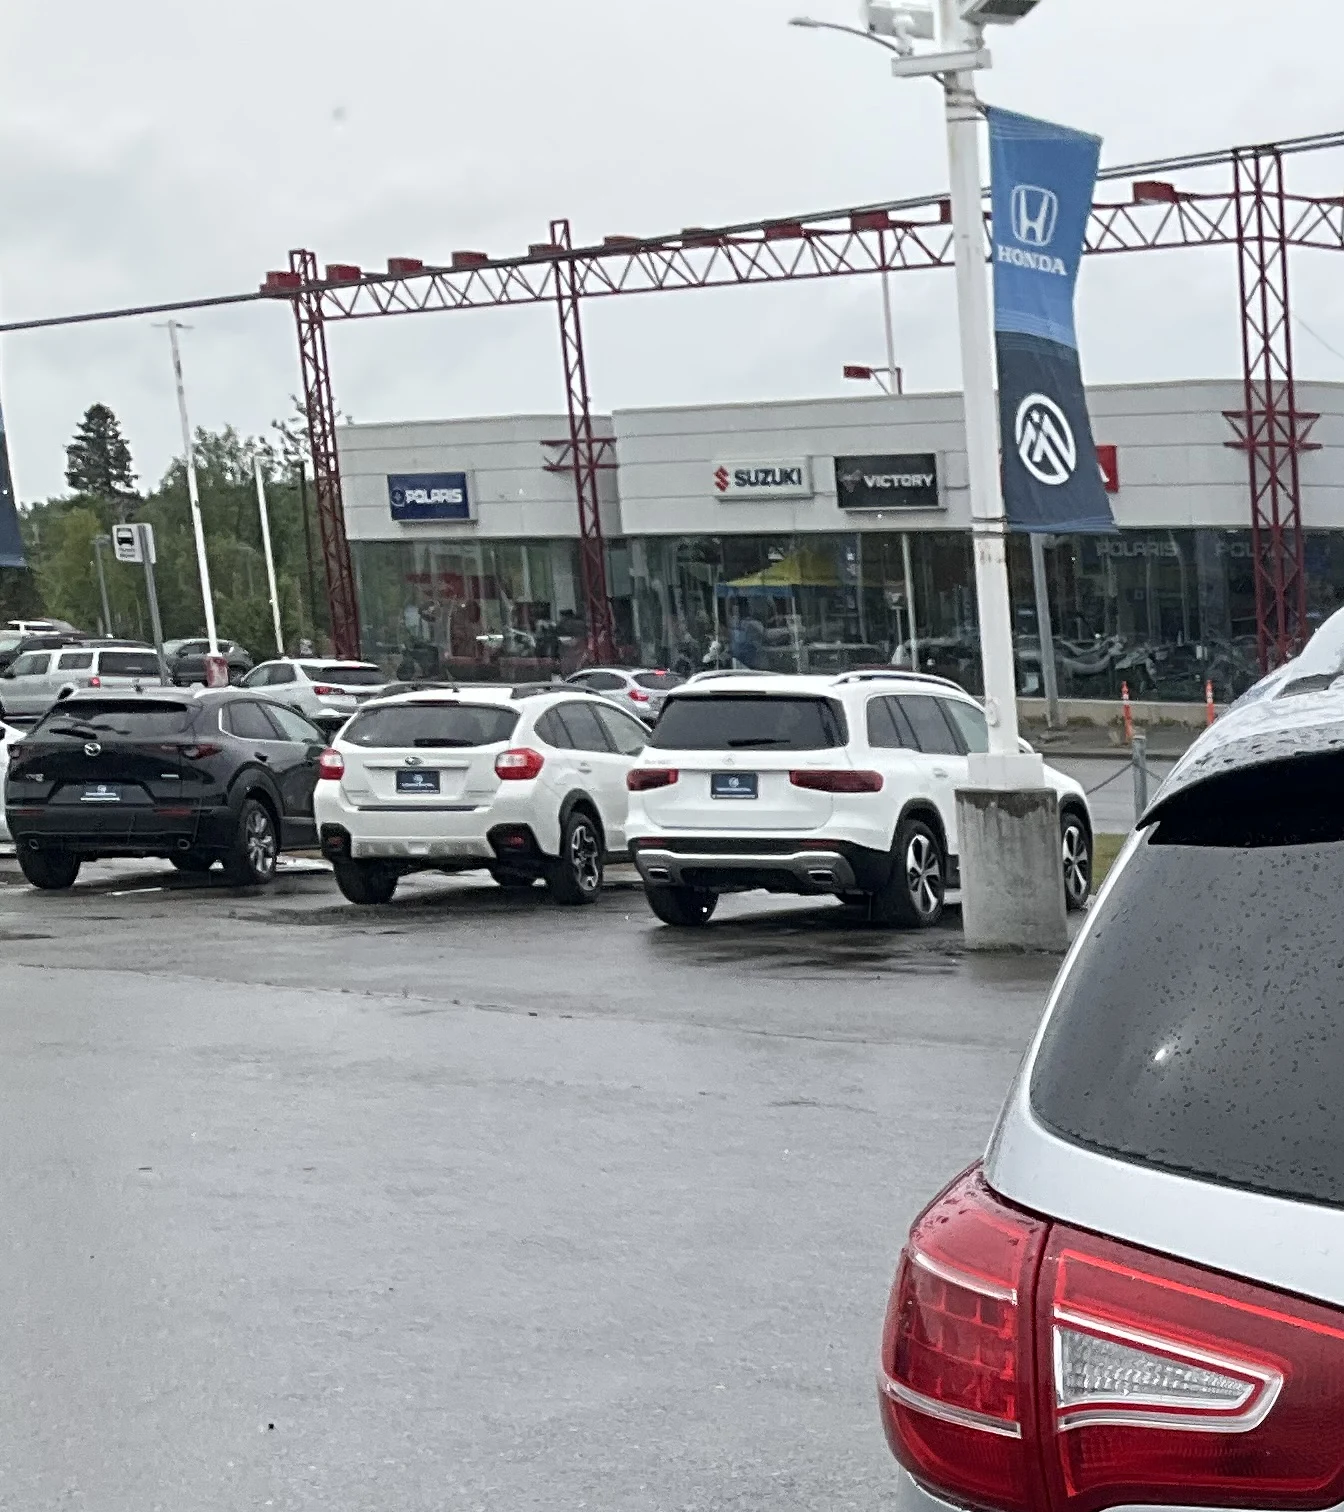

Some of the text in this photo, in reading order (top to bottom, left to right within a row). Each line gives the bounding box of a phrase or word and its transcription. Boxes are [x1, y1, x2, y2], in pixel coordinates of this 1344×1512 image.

[997, 244, 1068, 276] HONDA
[734, 467, 802, 488] SUZUKI
[863, 473, 934, 489] VICTORY
[405, 488, 463, 504] POLARIS
[1096, 541, 1177, 557] POLARIS
